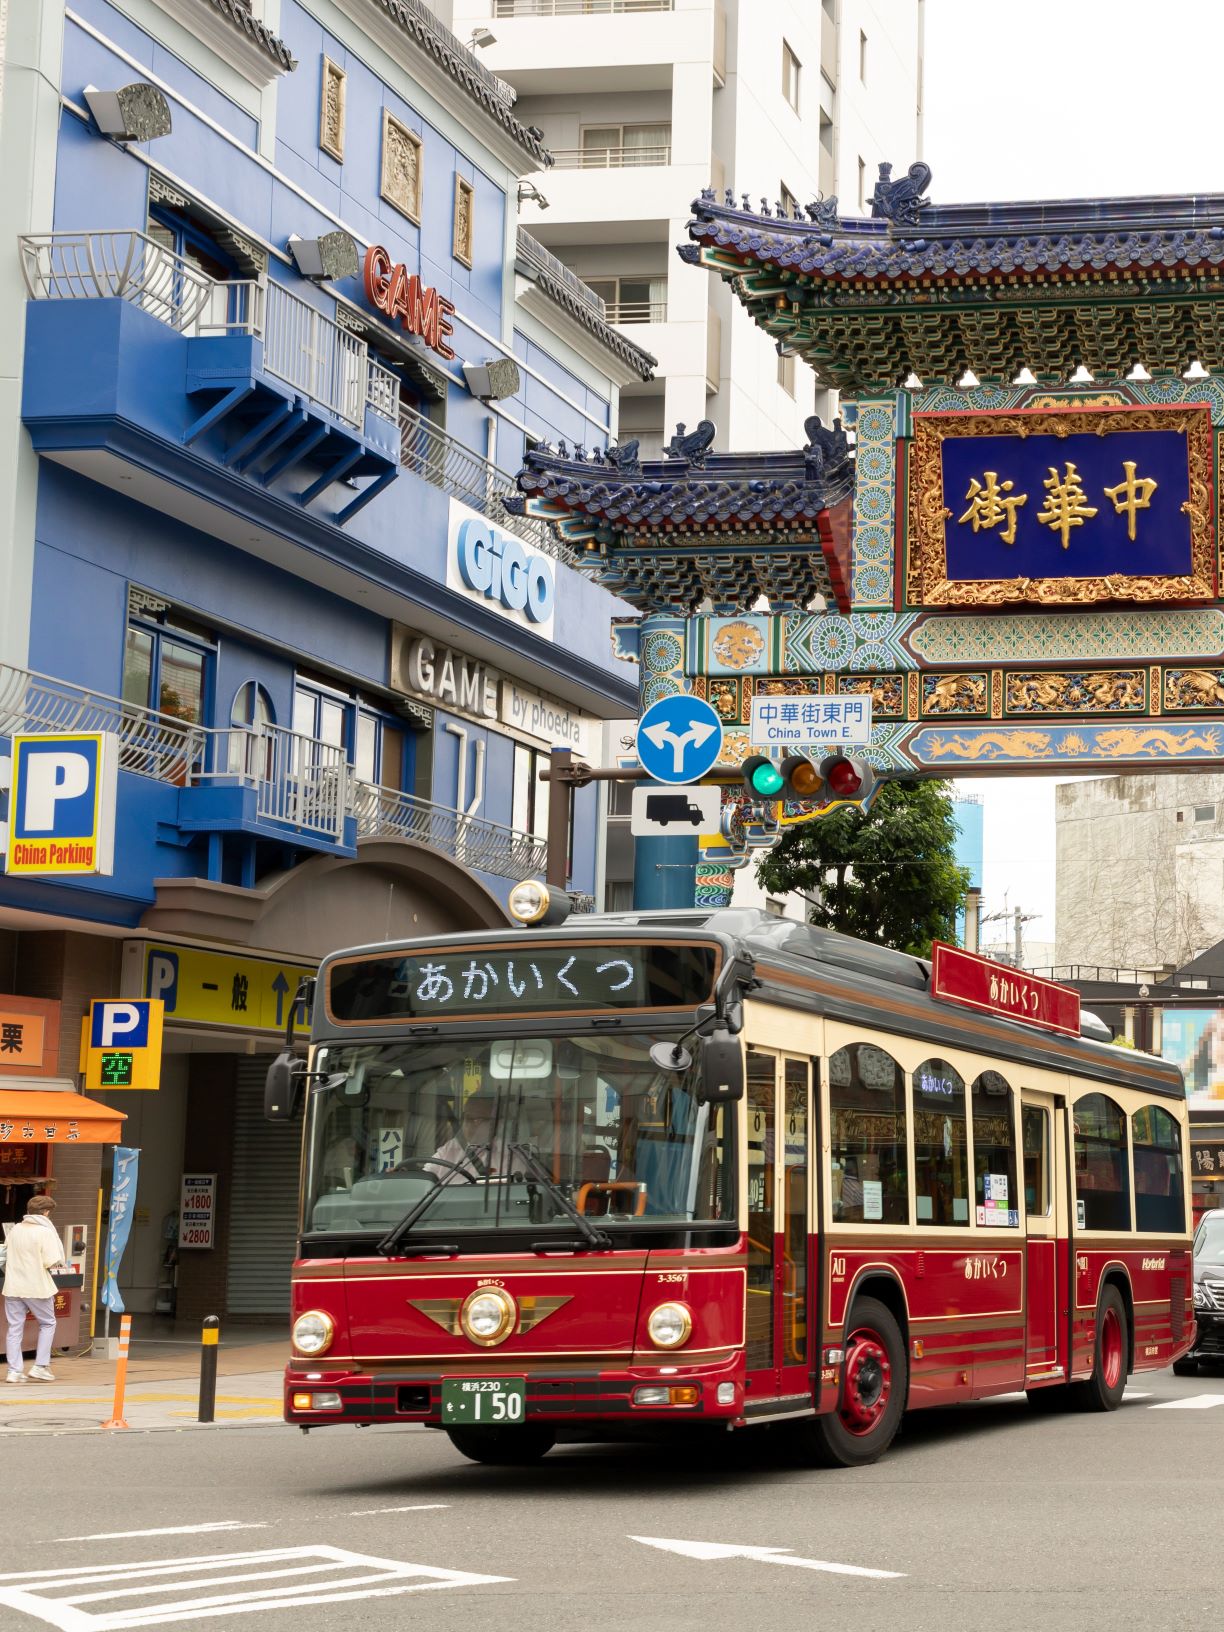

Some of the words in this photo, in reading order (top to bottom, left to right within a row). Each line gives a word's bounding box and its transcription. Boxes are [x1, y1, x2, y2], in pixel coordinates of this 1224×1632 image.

[364, 246, 455, 360] GAME
[958, 462, 1158, 550] 中華街
[457, 519, 554, 623] GiGO
[408, 637, 498, 719] GAME
[512, 687, 527, 727] by
[531, 700, 580, 743] phoedra
[759, 703, 863, 725] 中華街東門
[767, 727, 801, 740] China
[806, 727, 838, 740] Town
[841, 727, 853, 739] E.
[24, 752, 90, 831] P
[14, 844, 46, 865] China
[50, 843, 93, 866] Parking
[149, 957, 175, 1001] P
[202, 971, 248, 1011] 一般
[416, 955, 634, 1002] あかいくつ
[990, 974, 1039, 1011] あかいくつ
[0, 1023, 24, 1053] 栗
[102, 1004, 139, 1046] P
[102, 1052, 132, 1085] 空
[921, 1073, 952, 1094] あかいくつ
[185, 1195, 211, 1208] ¥1800
[183, 1230, 210, 1243] ¥2800
[657, 1274, 687, 1282] 3-3567
[832, 1258, 846, 1275] 入口
[964, 1258, 1007, 1280] あかいくつ
[1142, 1258, 1165, 1270] Hybrid
[461, 1381, 501, 1392] 横浜230
